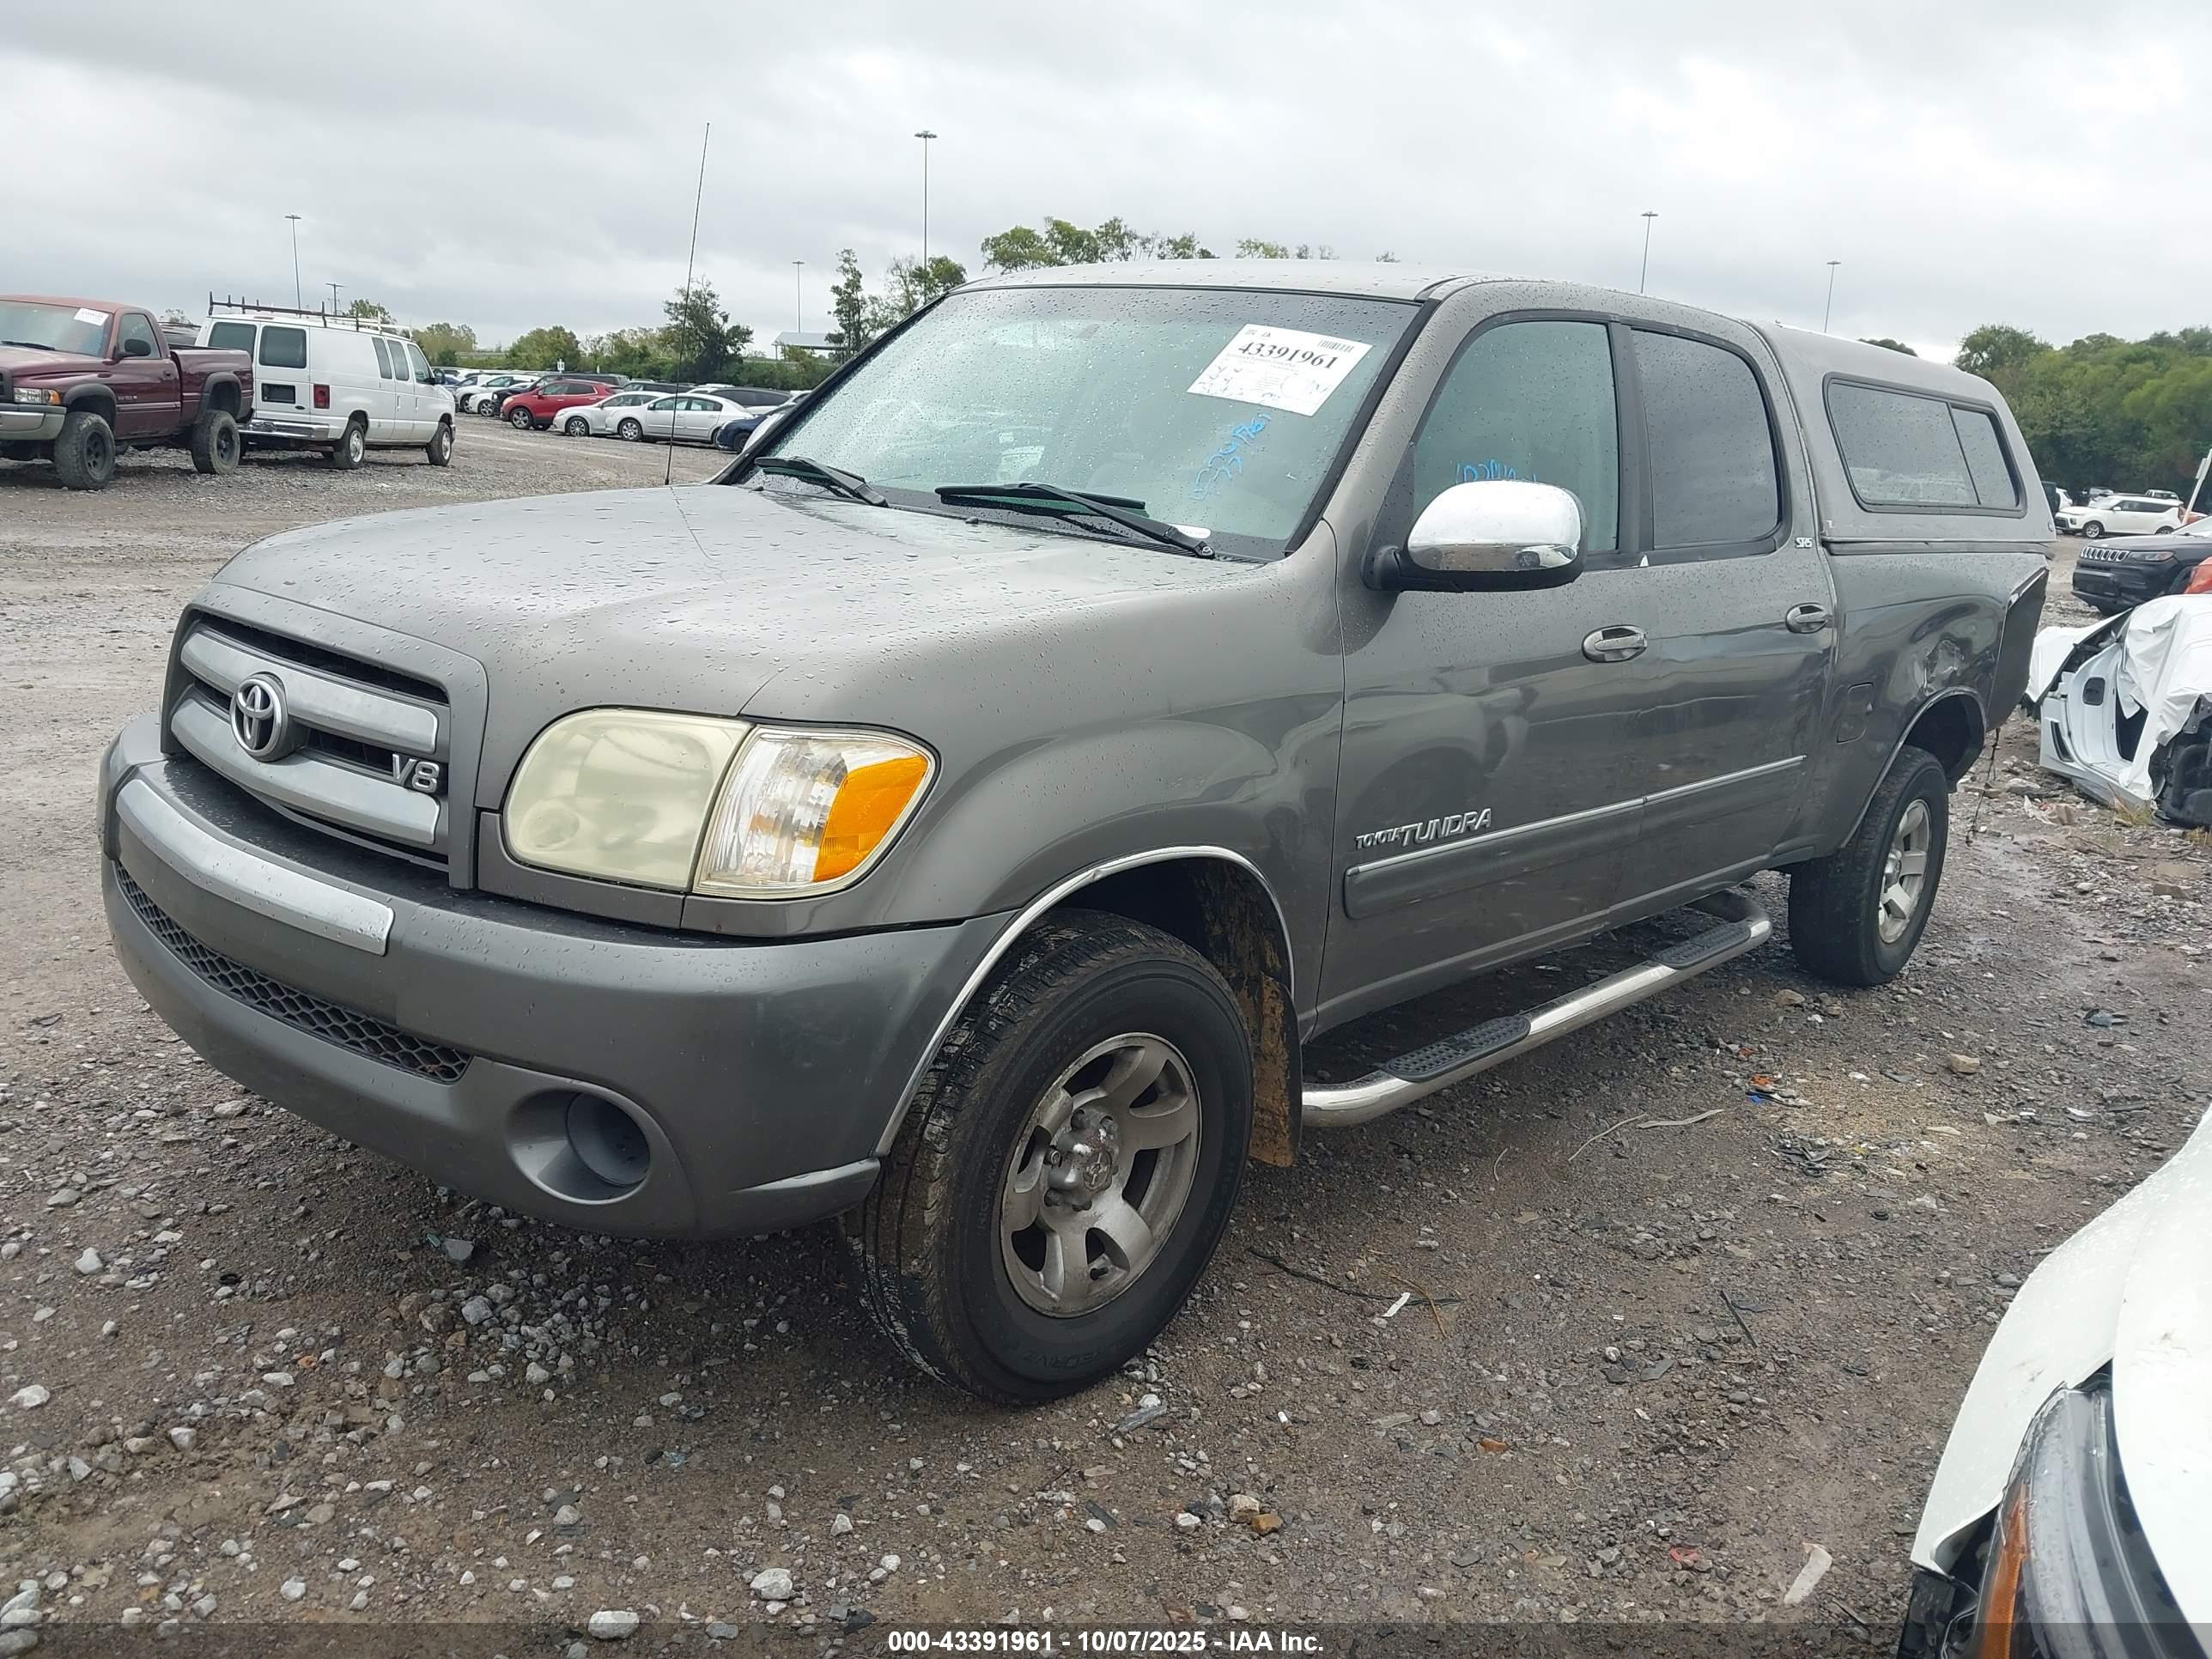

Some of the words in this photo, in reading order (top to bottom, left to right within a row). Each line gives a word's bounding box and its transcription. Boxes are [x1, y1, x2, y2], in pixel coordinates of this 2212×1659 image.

[1237, 341, 1340, 369] 43391961
[1795, 537, 1813, 548] SR5
[392, 752, 440, 793] V8
[1355, 827, 1401, 850] TOYOTA
[1400, 807, 1492, 848] TUNDRA
